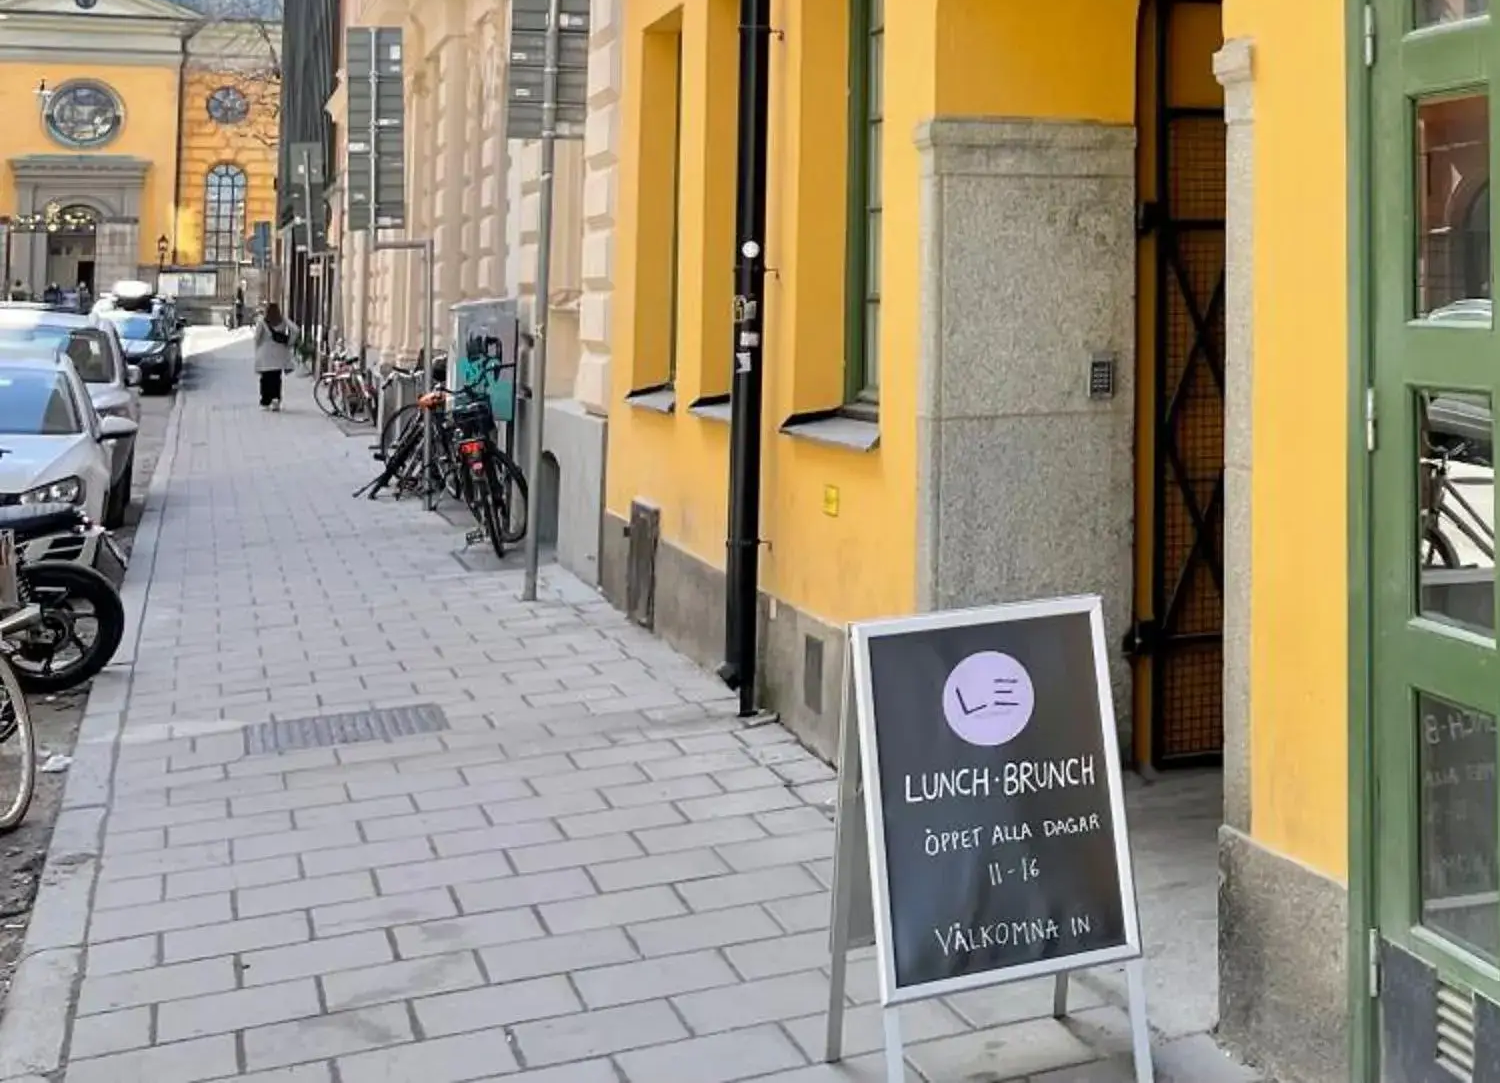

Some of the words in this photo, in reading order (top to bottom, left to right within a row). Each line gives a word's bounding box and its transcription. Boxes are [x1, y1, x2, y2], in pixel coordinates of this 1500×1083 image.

[904, 767, 991, 804] LUNCH
[1003, 753, 1096, 797] BRUNCH
[924, 825, 984, 857] ÖPPET
[991, 822, 1033, 847] ALLA
[1042, 812, 1101, 837] DAGAR
[934, 917, 1059, 958] VÄLKOMNA
[1070, 914, 1092, 938] IN
